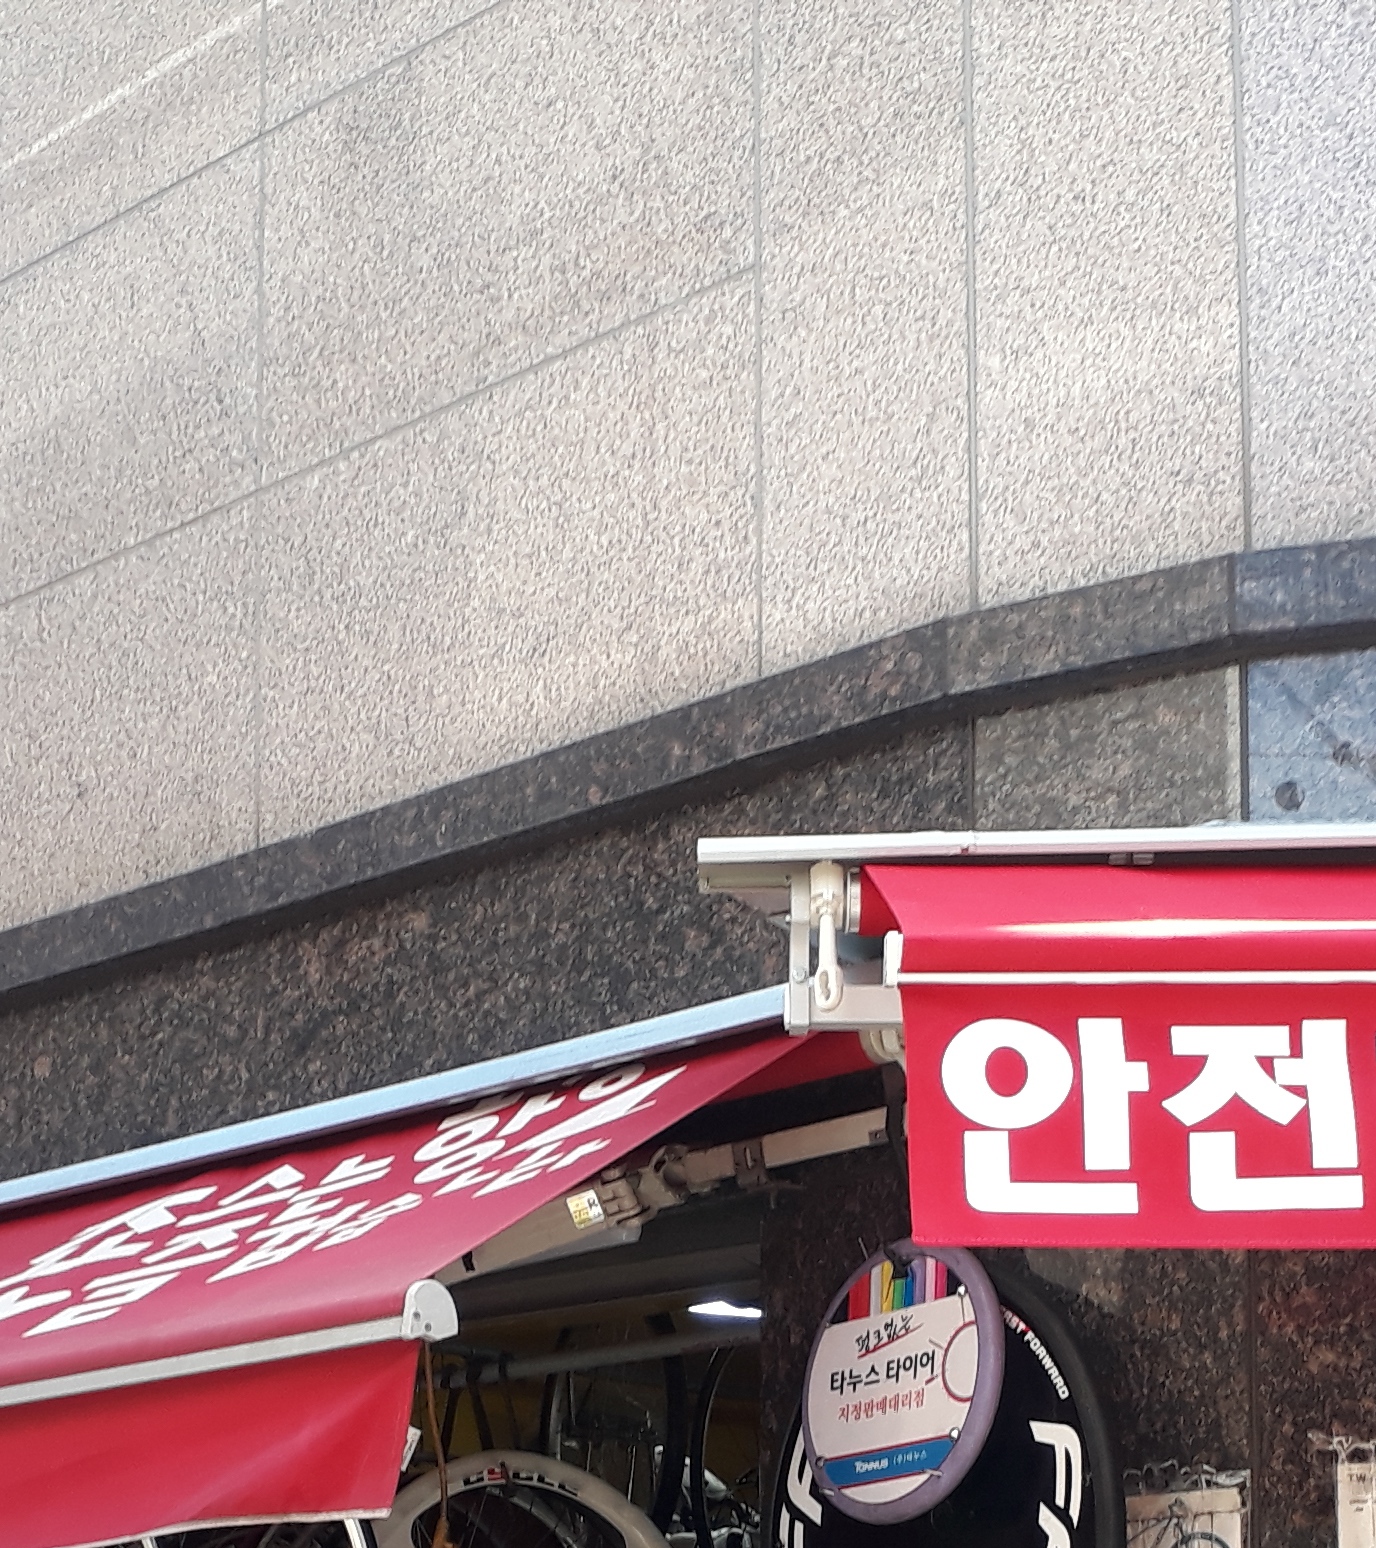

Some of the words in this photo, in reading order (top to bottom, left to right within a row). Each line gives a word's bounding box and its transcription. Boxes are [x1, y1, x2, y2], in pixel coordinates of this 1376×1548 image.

[830, 1364, 880, 1395] 타누스
[886, 1349, 936, 1384] 타이어
[838, 1387, 925, 1423] 지정판매대리점
